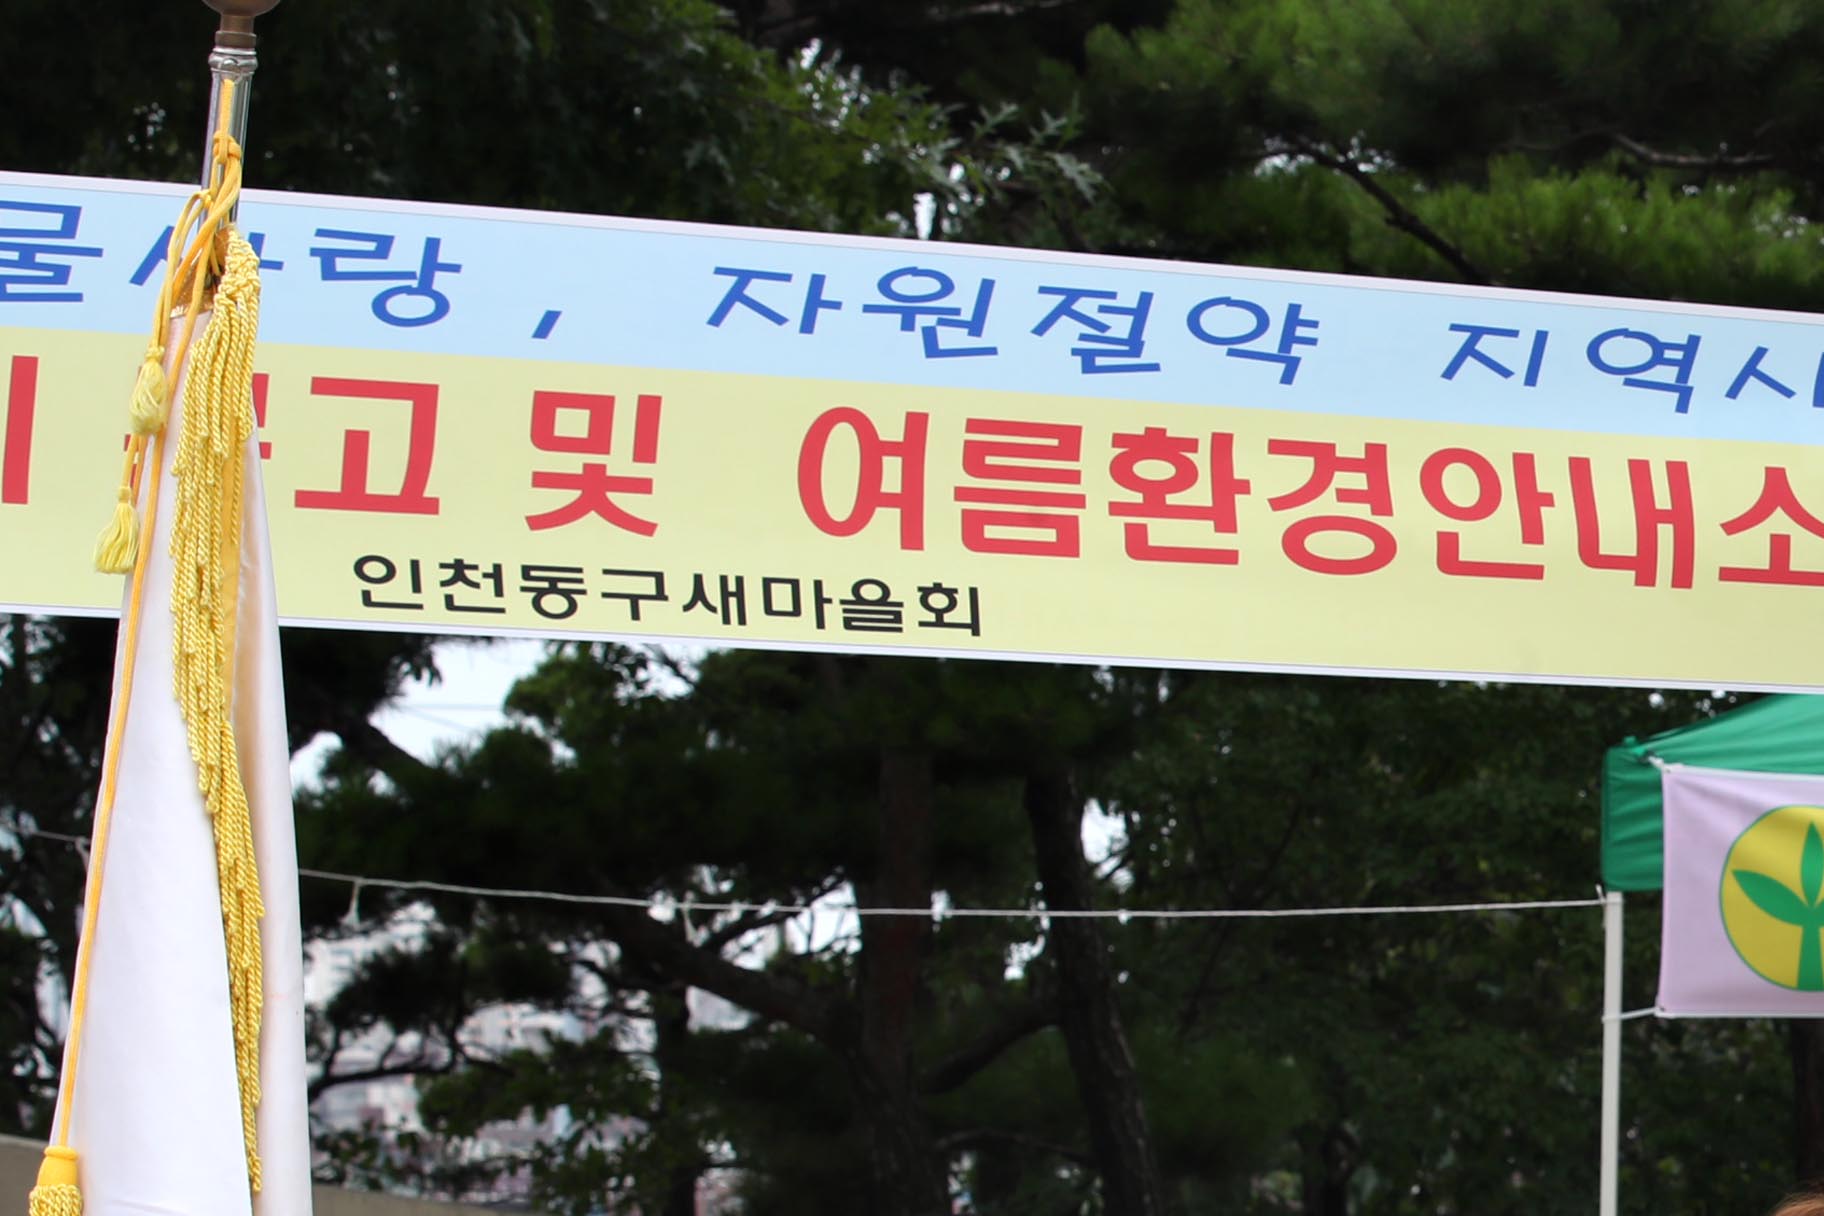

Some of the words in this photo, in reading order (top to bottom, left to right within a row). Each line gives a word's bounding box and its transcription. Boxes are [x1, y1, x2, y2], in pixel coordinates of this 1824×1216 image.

[706, 265, 1320, 386] 자원절약
[526, 390, 663, 537] 및
[352, 553, 983, 638] 인천동구새마을회
